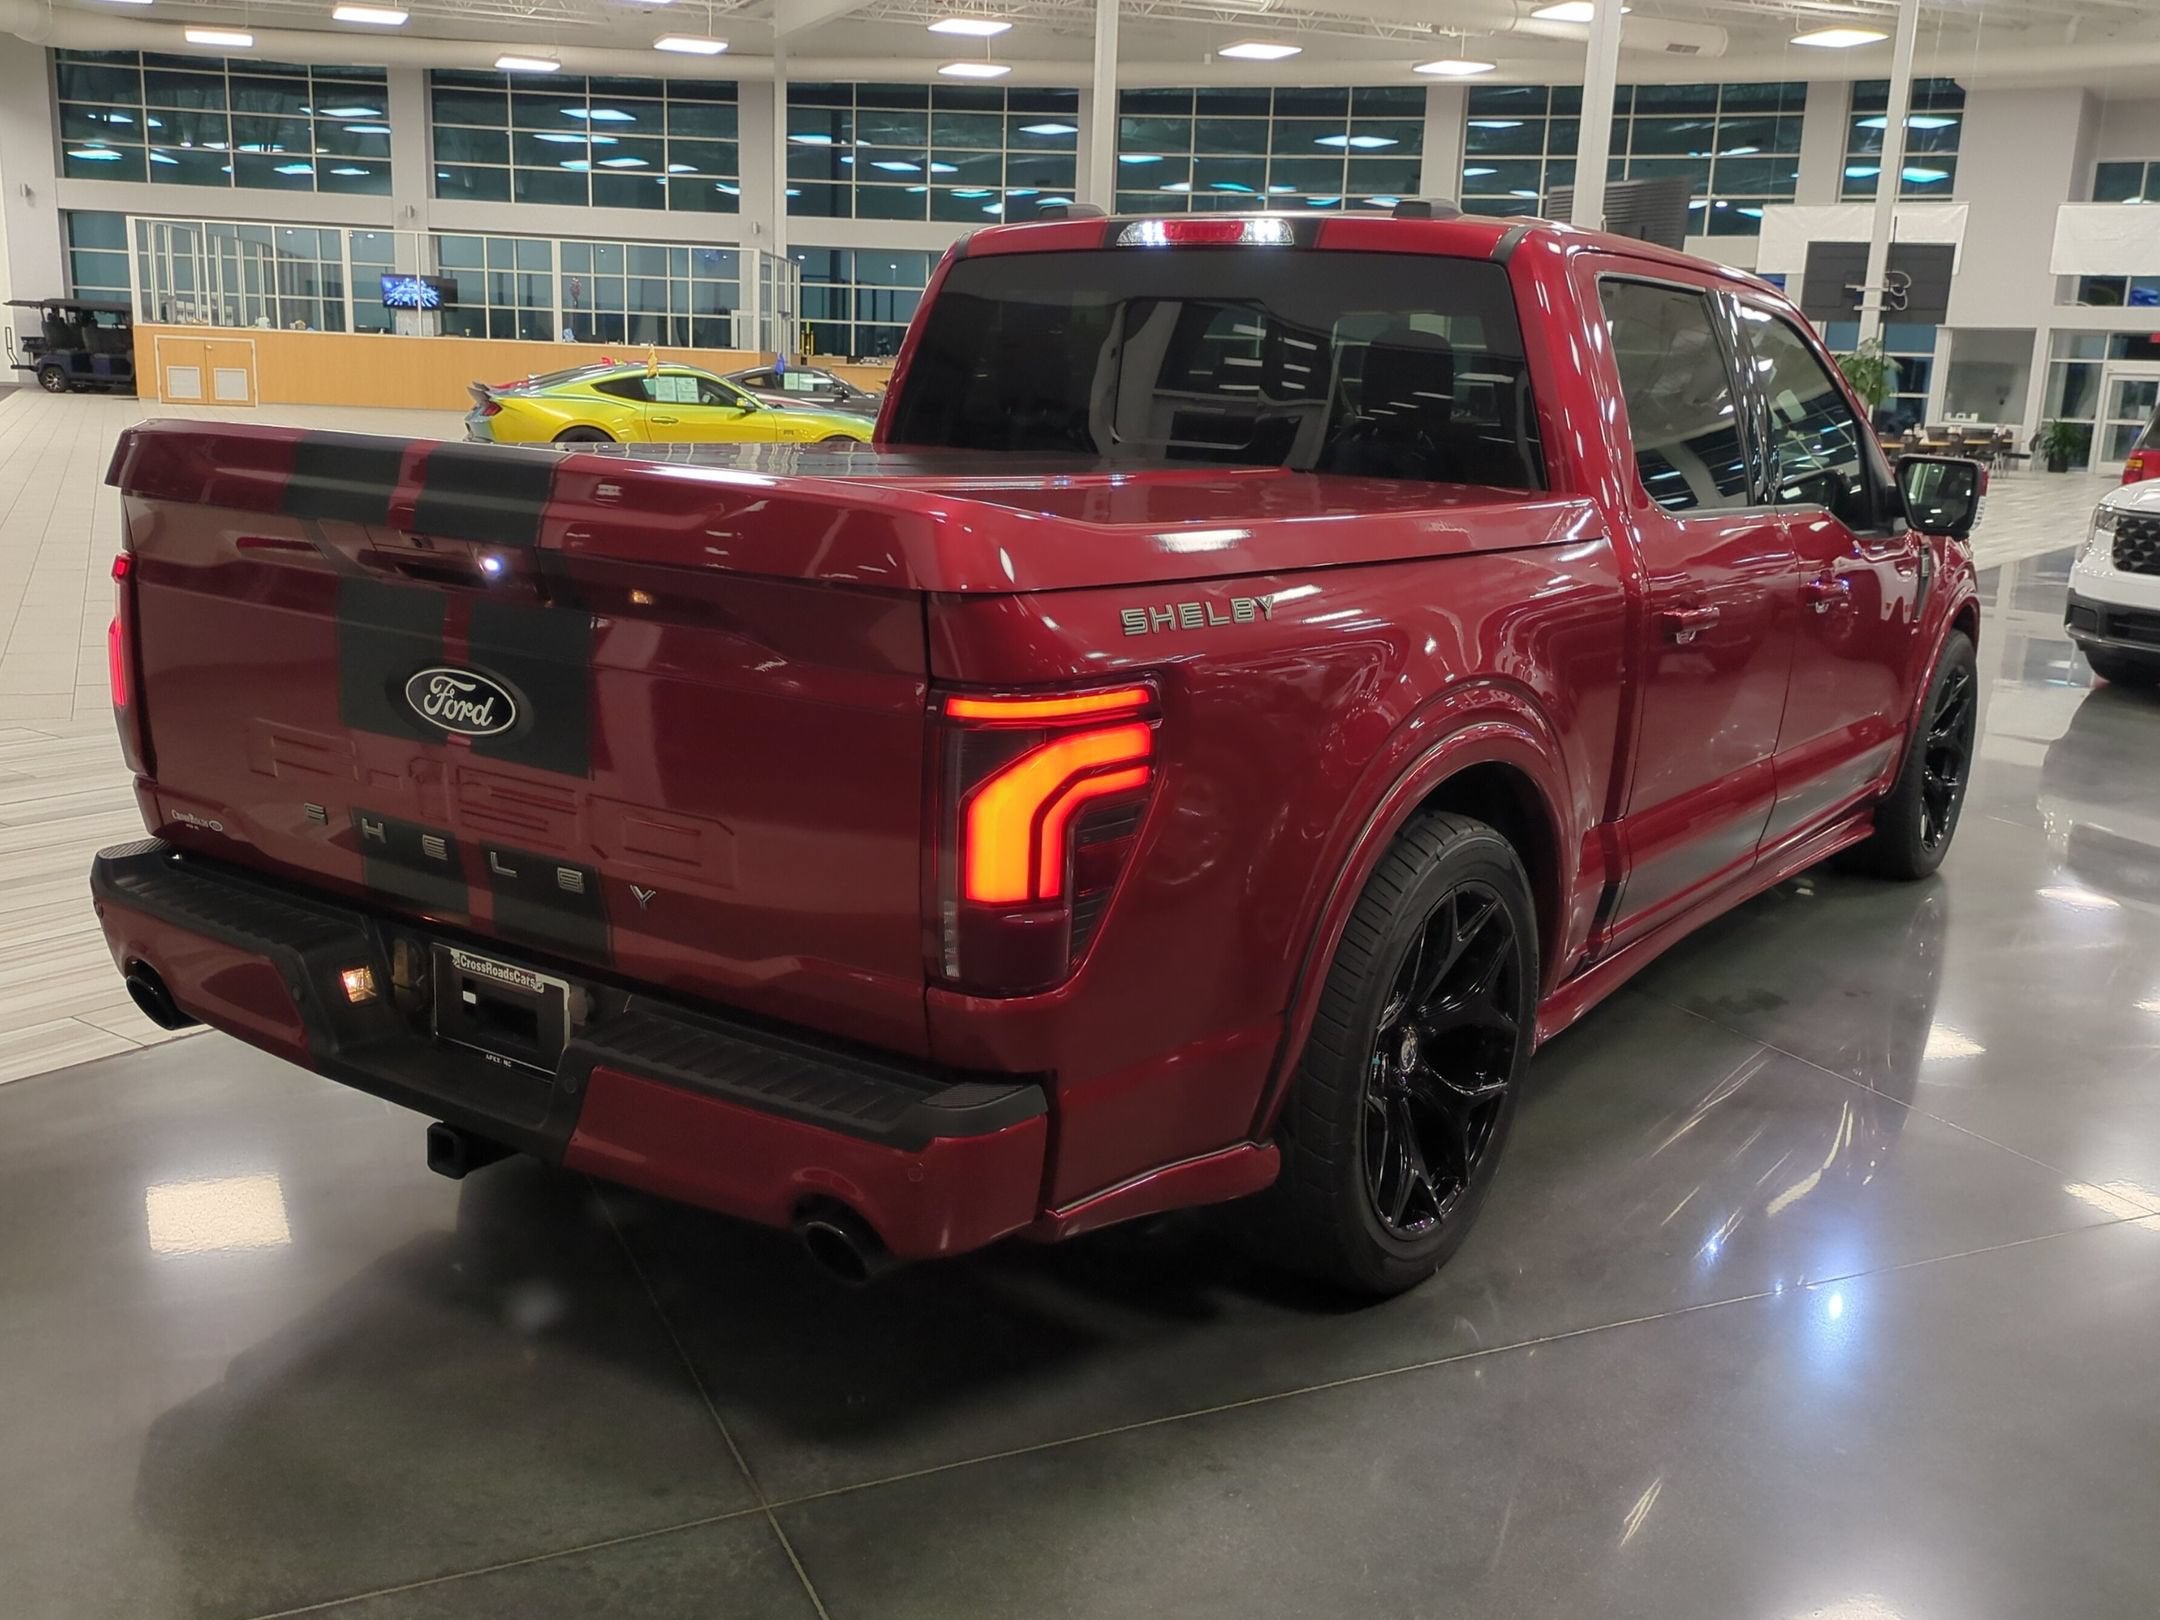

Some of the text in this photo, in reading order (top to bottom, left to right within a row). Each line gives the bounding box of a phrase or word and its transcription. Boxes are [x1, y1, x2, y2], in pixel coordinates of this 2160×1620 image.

[1120, 594, 1275, 636] SHELBY
[423, 675, 495, 727] Ford
[303, 802, 657, 911] SHELBY
